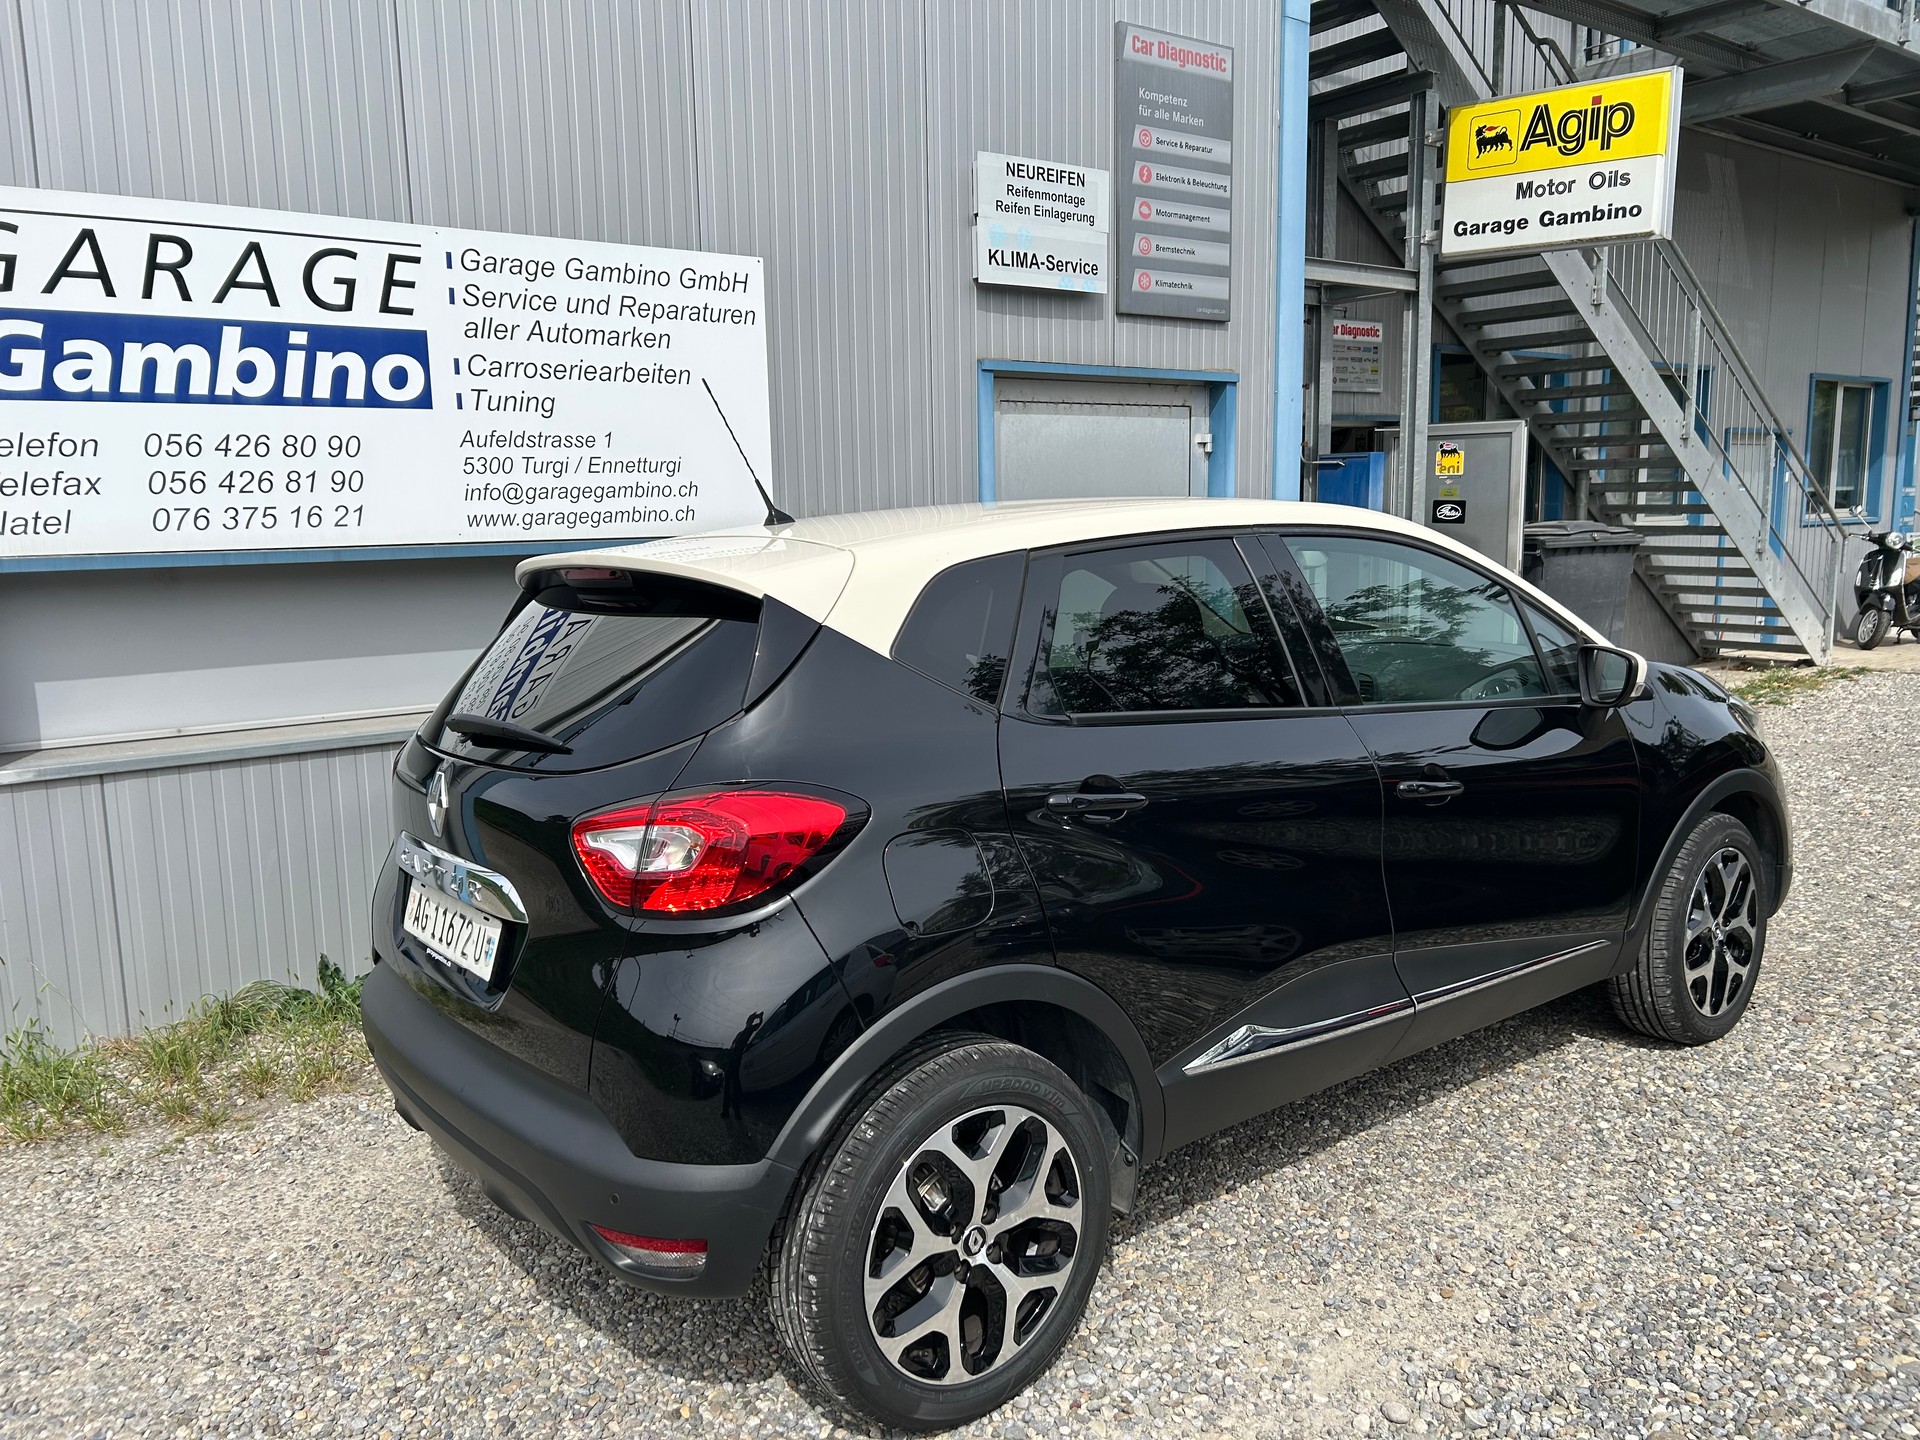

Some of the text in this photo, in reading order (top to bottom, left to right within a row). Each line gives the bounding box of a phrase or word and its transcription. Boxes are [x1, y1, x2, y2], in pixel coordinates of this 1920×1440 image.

[1132, 35, 1226, 72] Car Diagnostic
[1139, 87, 1188, 107] Kompetenz
[1139, 104, 1204, 127] für alle Marken
[1519, 95, 1636, 156] Agip
[1156, 137, 1213, 154] Service & Reparatur
[1007, 162, 1084, 187] NEUREIFEN
[1156, 173, 1228, 192] Elektronik & Beleuchtung
[1516, 170, 1630, 200] Motor Oils
[1006, 184, 1085, 207] Reifenmontage
[996, 200, 1094, 226] Reifen Einlagerung
[1156, 208, 1210, 223] Motormanagement
[1454, 203, 1642, 237] Garage Gambino
[989, 249, 1098, 275] KLIMA-Service
[1156, 244, 1196, 256] Bremstechnik
[461, 249, 748, 293] Garage Gambino GmbH
[1155, 279, 1193, 290] Klimatechnik
[463, 284, 755, 325] Service und Reparaturen
[465, 317, 670, 349] aller Automarken
[1341, 324, 1380, 339] Diagnostic
[0, 319, 425, 401] Gambino
[468, 354, 690, 384] Carroseriearbeiten
[471, 389, 555, 418] Tuning
[0, 432, 360, 457] elefon 056 426 80 90
[460, 430, 611, 448] Aufeldstrasse 1
[463, 457, 680, 478] 5300 Turgi / Ennetturgi
[1439, 461, 1460, 474] eni
[0, 470, 363, 496] elefax 056 426 81 90
[465, 481, 698, 505] info@garagegambino.ch
[153, 508, 210, 531] 076
[223, 507, 277, 530] 375
[291, 506, 322, 528] 16
[334, 505, 363, 527] 21
[467, 505, 694, 530] www.garagegambino.ch
